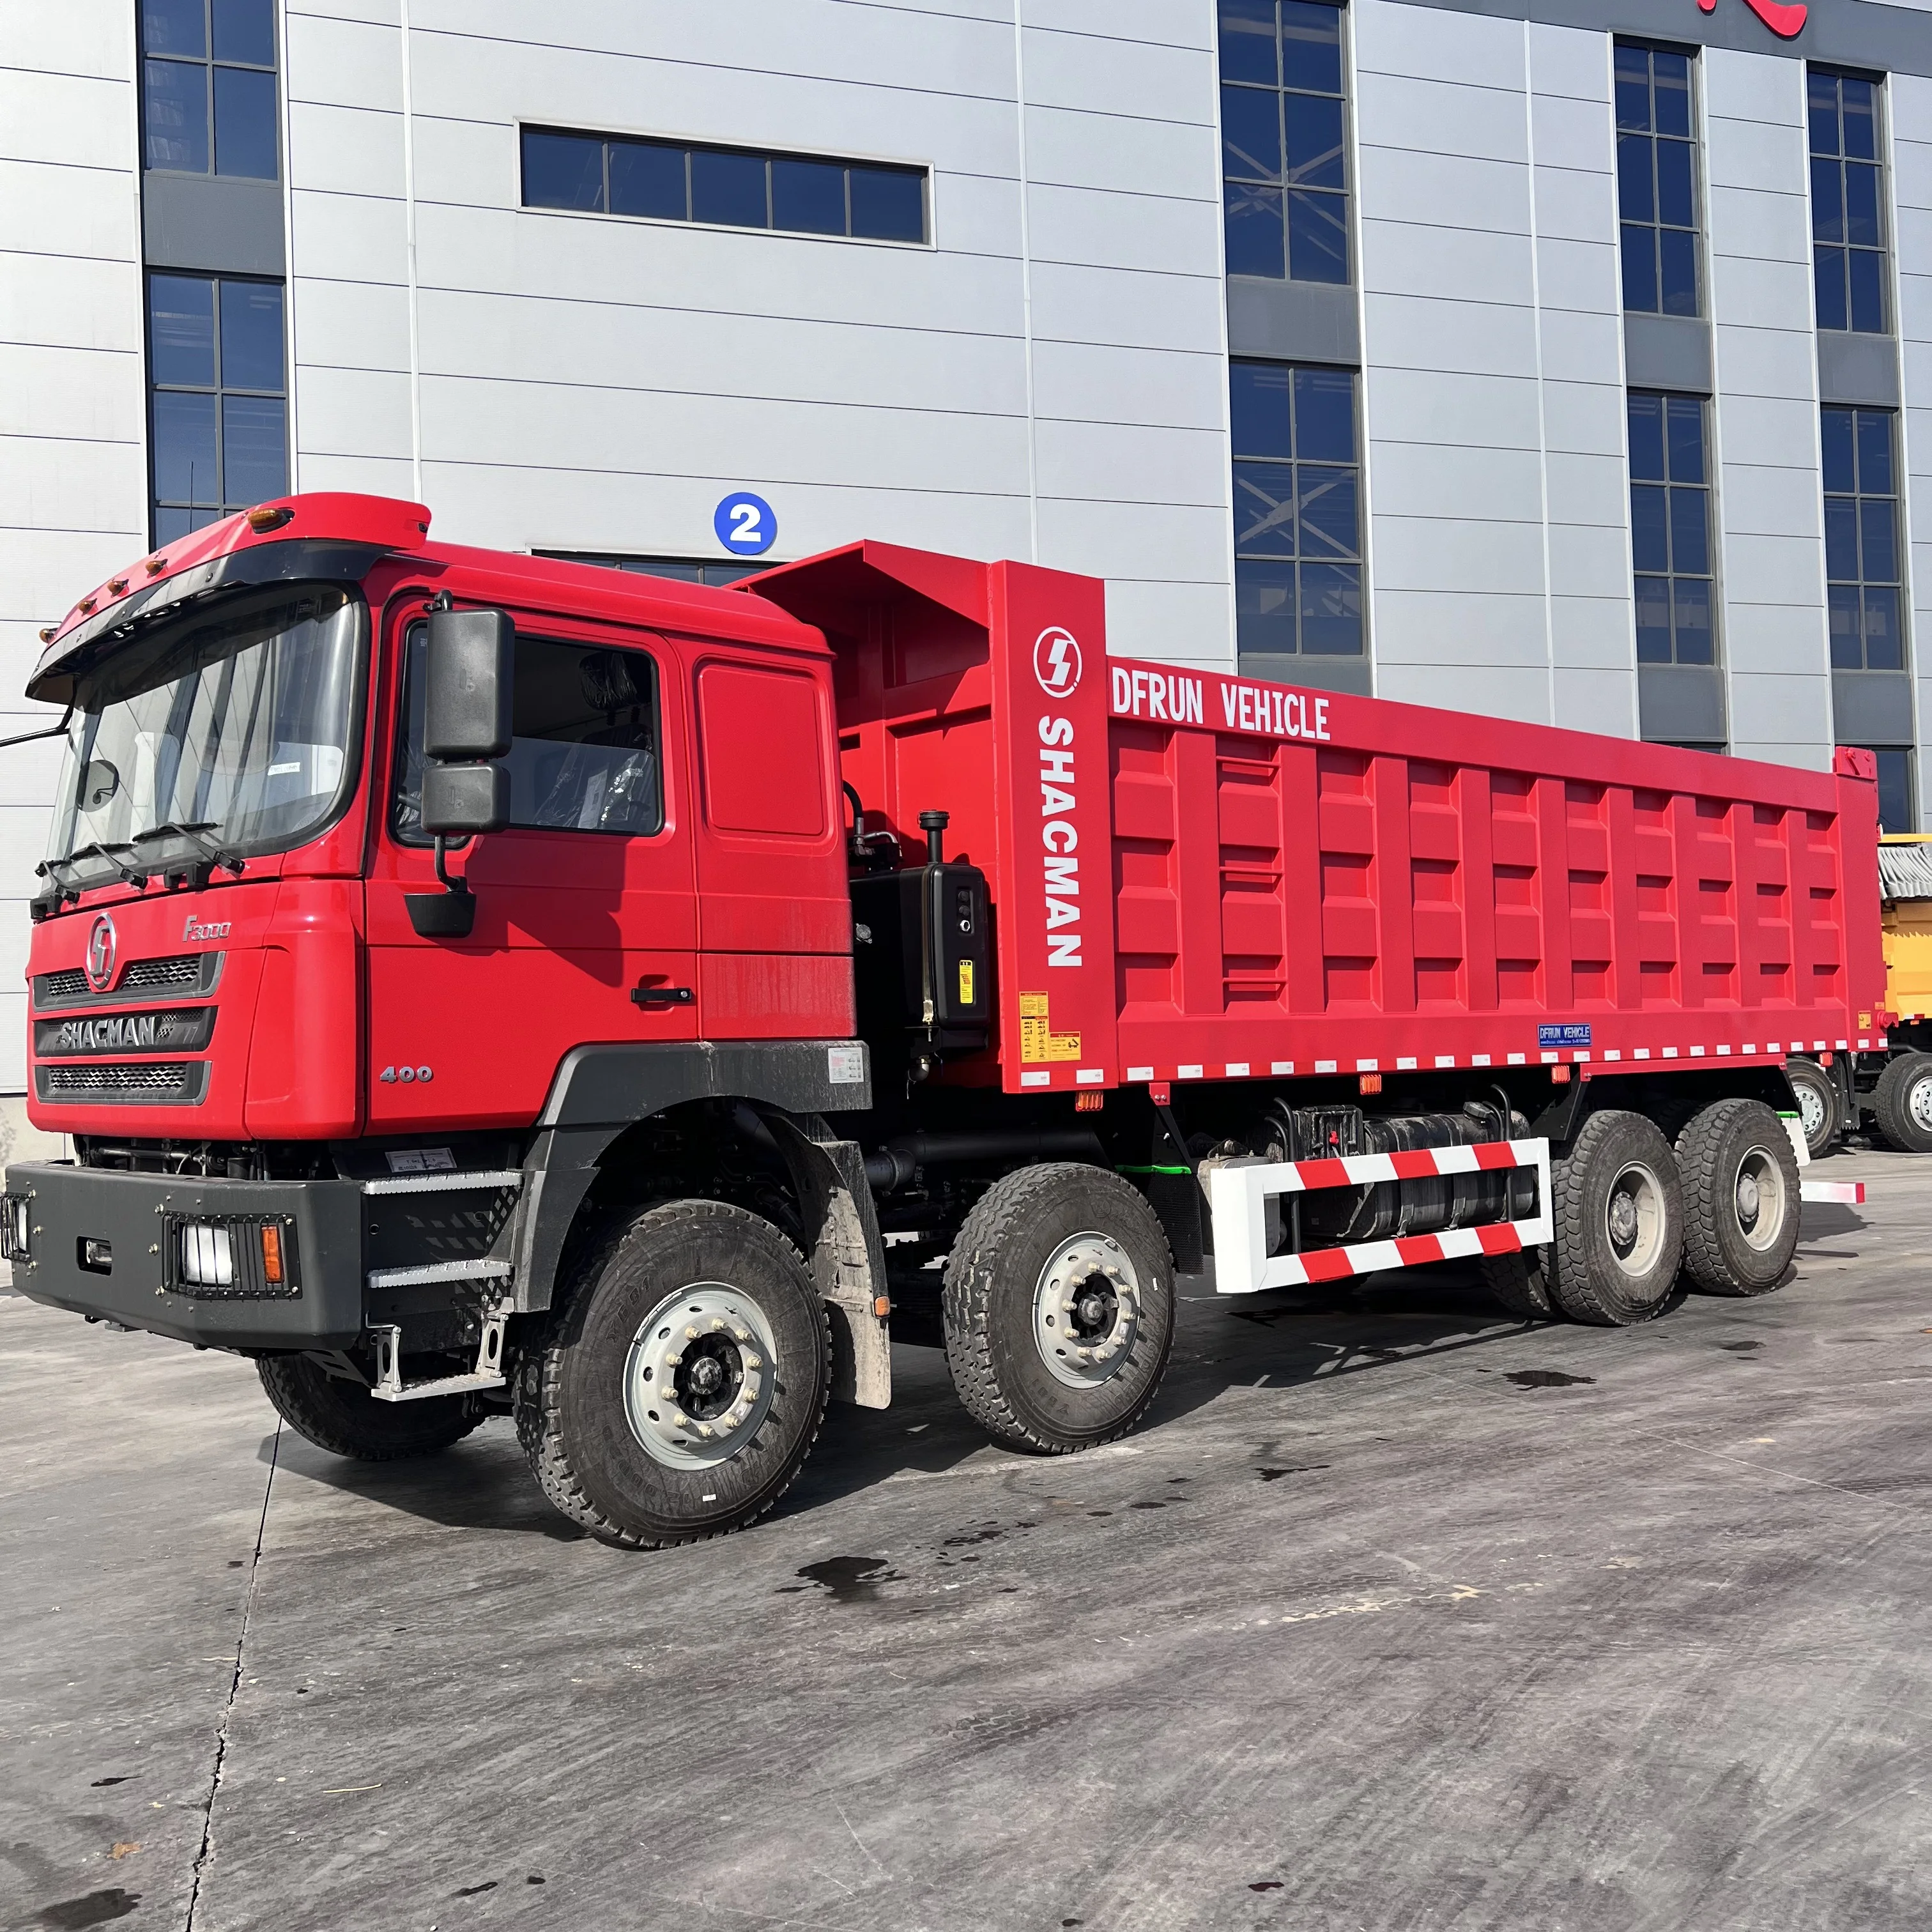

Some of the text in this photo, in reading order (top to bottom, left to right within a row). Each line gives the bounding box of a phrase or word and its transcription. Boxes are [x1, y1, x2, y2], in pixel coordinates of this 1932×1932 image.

[730, 503, 761, 542] 2
[1112, 666, 1331, 740] DFRUN VEHICLE
[1038, 716, 1083, 967] SHACMAN
[182, 914, 232, 942] F3000
[61, 1016, 155, 1048] SHACMAN
[1540, 1026, 1590, 1039] DFRUN VEHICLE
[379, 1066, 433, 1083] 400
